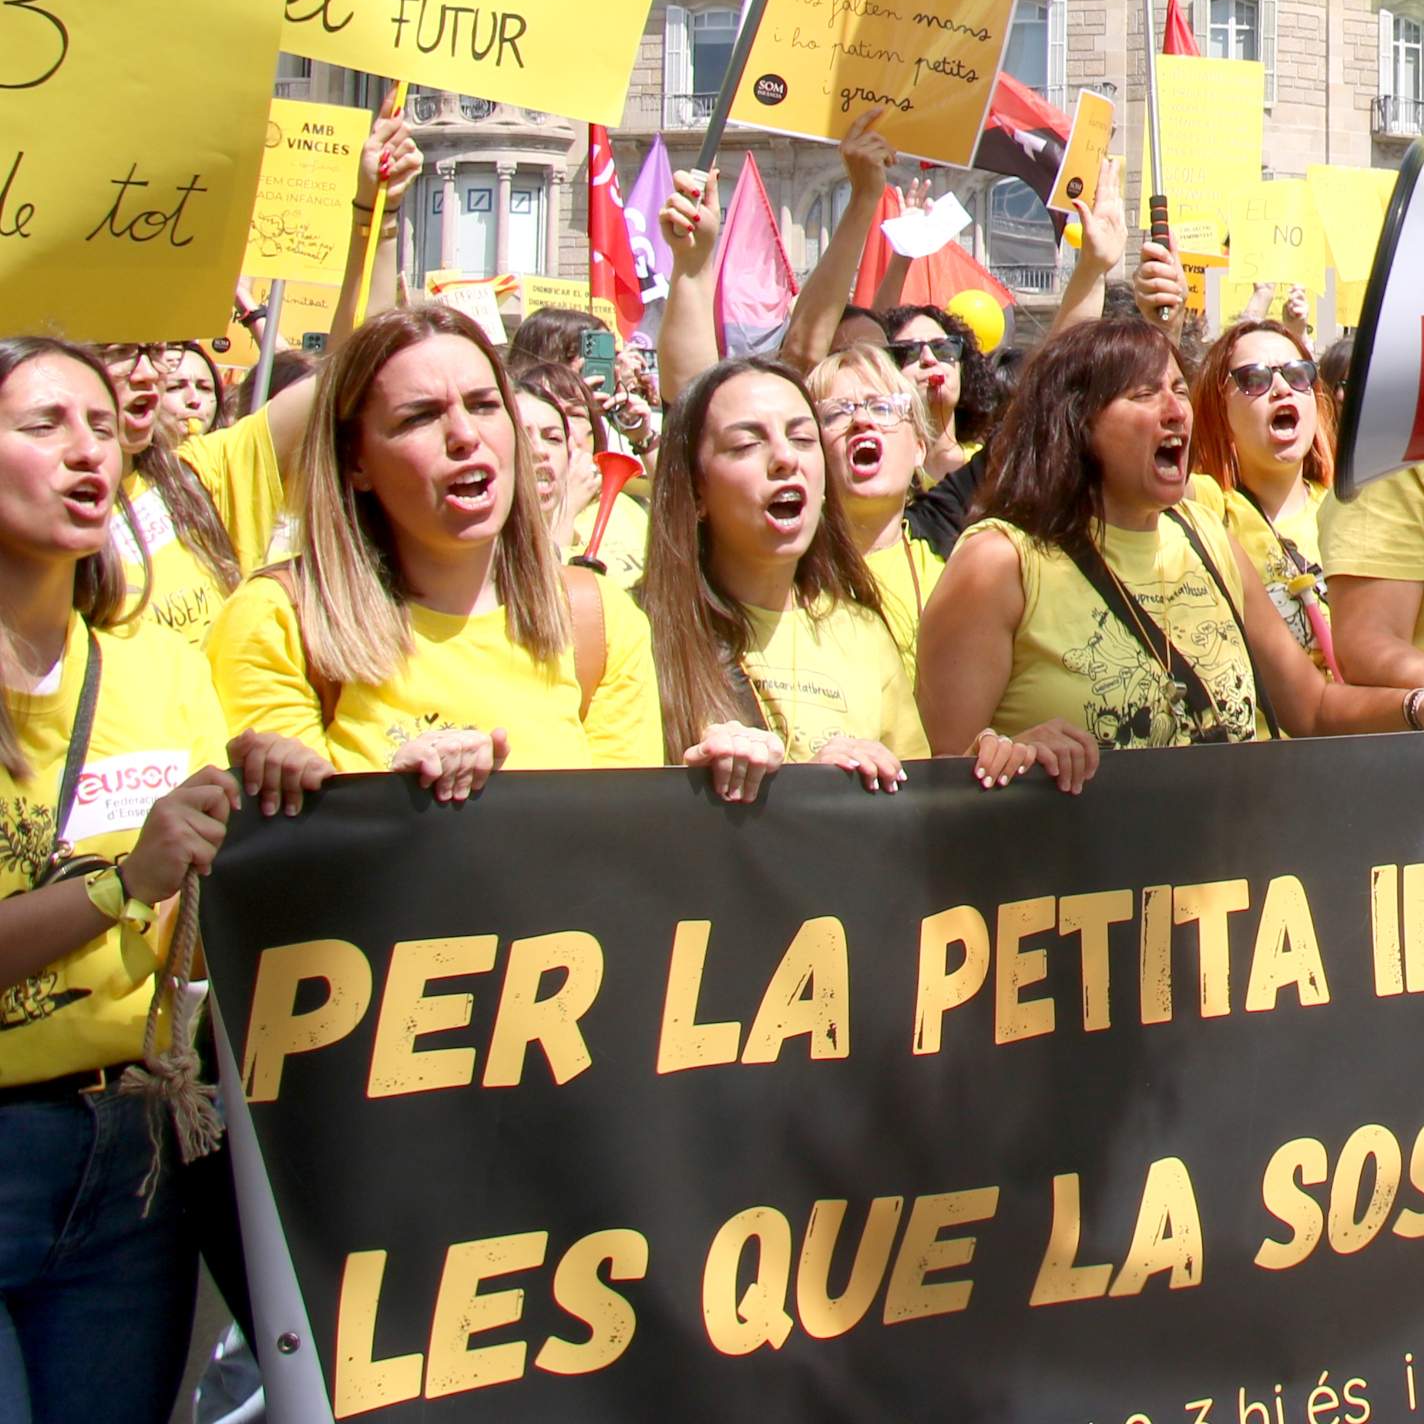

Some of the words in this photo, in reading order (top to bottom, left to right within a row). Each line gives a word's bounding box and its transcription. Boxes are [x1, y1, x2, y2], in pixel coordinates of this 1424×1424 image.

[912, 12, 992, 42] mans
[791, 28, 821, 49] ho
[829, 40, 905, 70] patim
[913, 54, 979, 87] petits
[758, 80, 784, 93] SOM
[840, 88, 914, 112] grans
[301, 122, 335, 136] AMB
[287, 137, 350, 155] VINCLES
[86, 162, 207, 247] tot
[1274, 225, 1303, 247] NO
[241, 931, 604, 1103] PER
[656, 916, 850, 1074] LA
[912, 874, 1331, 1055] PETITA
[334, 1228, 649, 1420] LES
[702, 1186, 1000, 1356] QUE
[1030, 1156, 1204, 1307] LA
[1307, 1370, 1371, 1424] és
[1404, 1353, 1416, 1410] i
